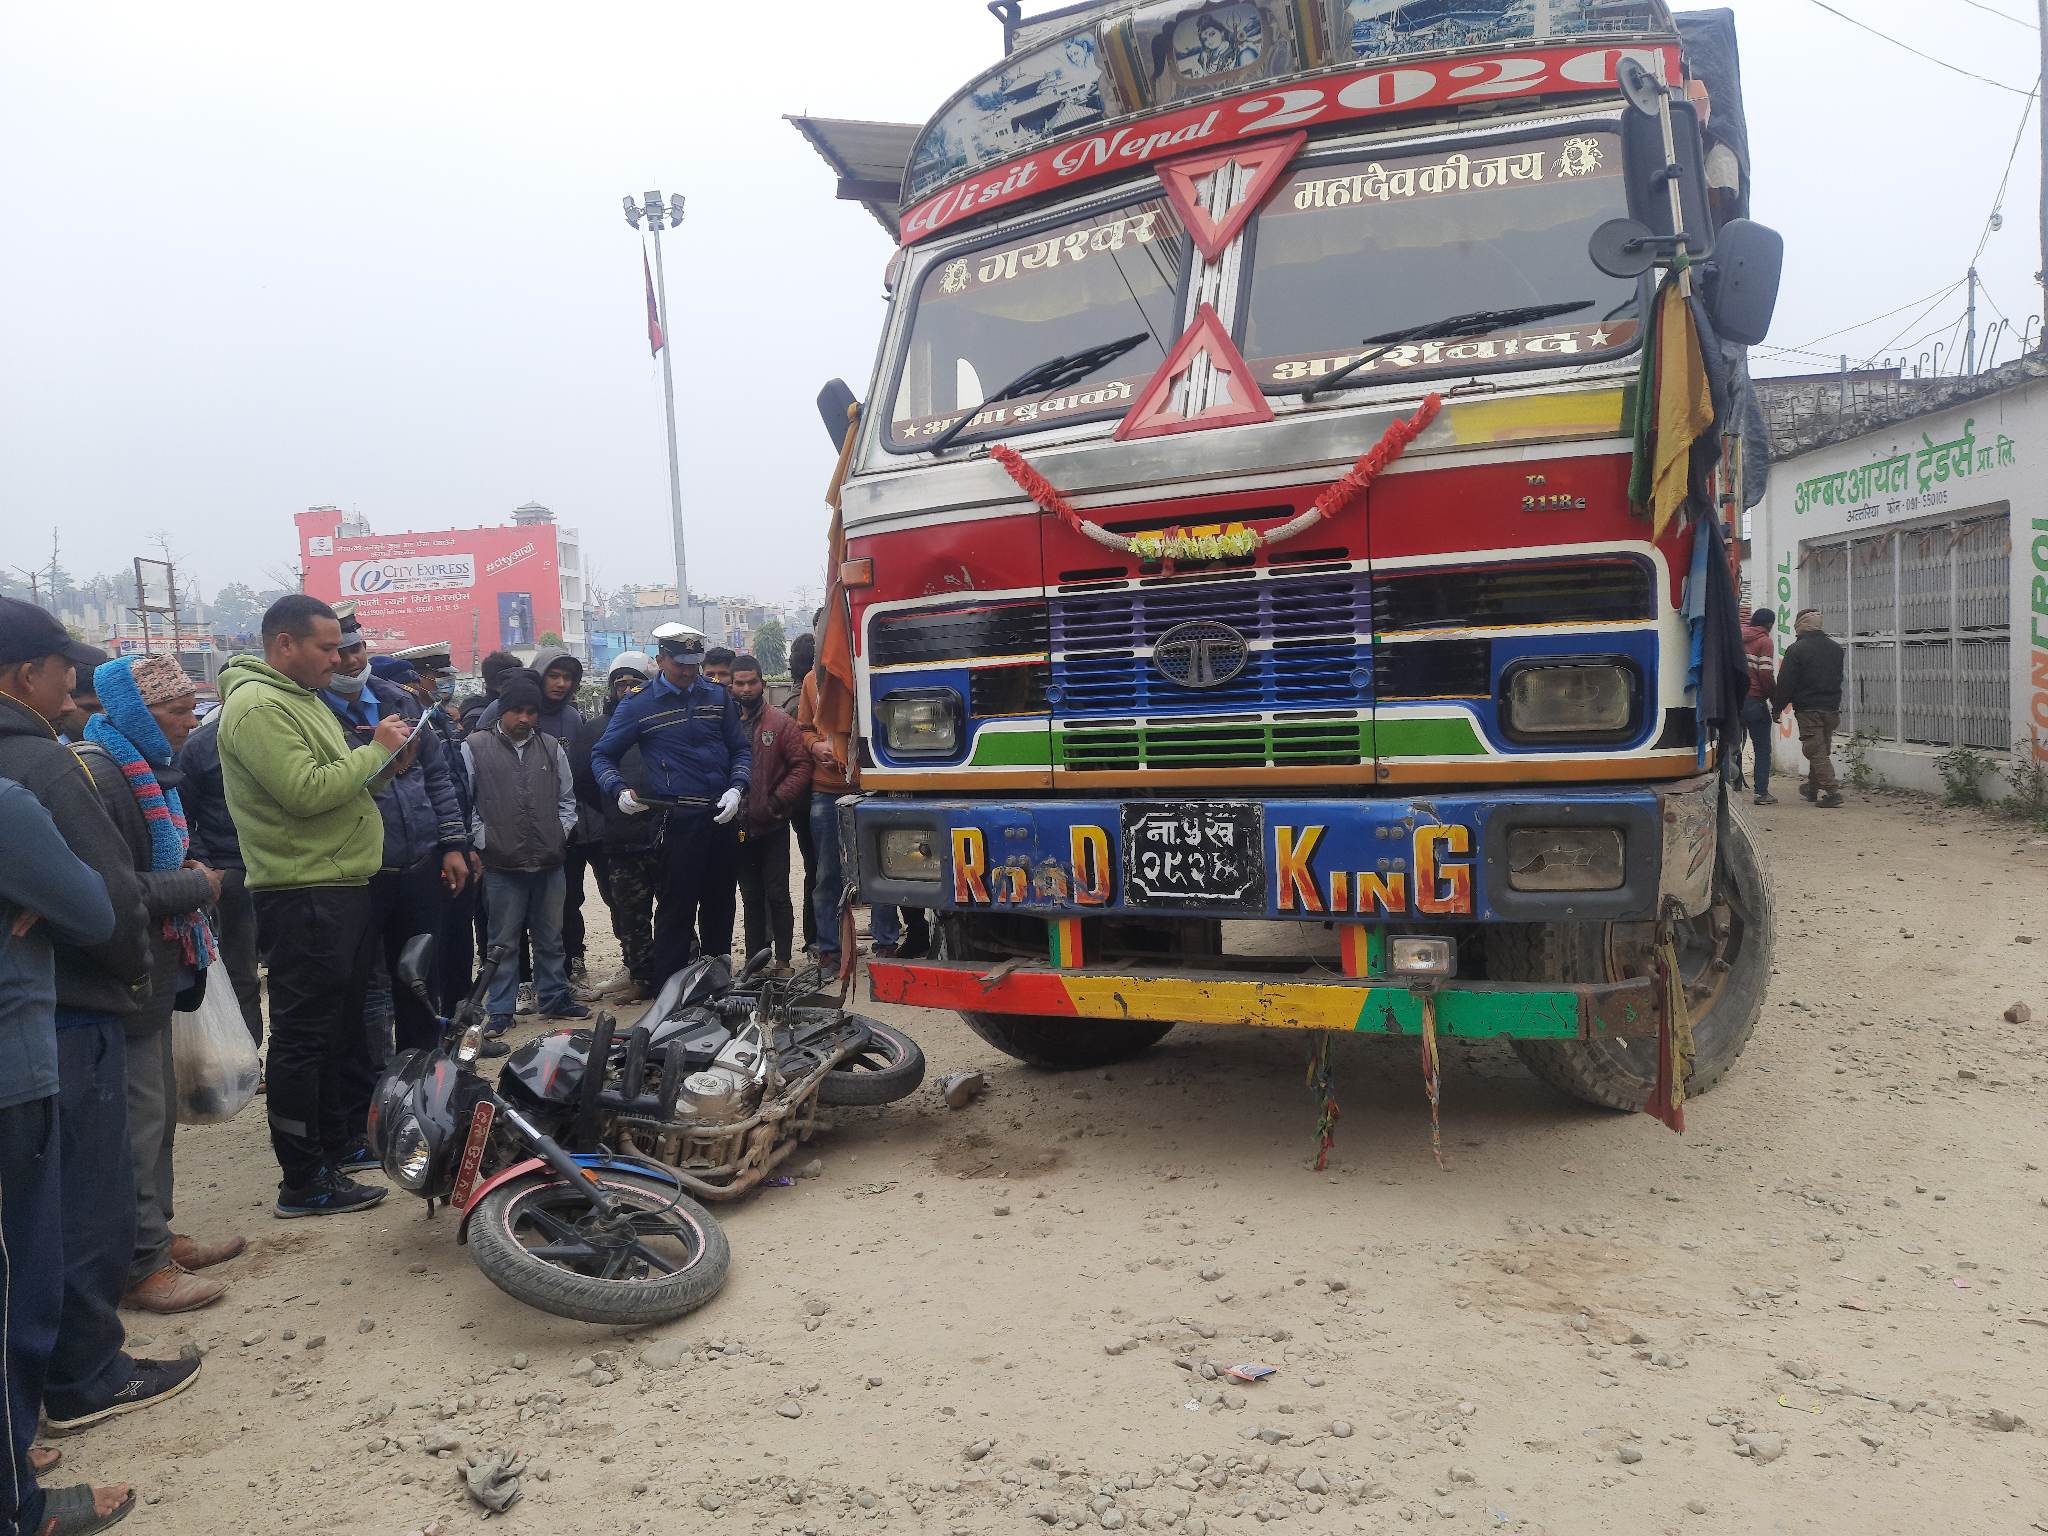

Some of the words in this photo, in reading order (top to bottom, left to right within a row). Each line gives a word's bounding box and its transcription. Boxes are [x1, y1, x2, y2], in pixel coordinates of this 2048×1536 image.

[905, 161, 1042, 234] Visit
[1052, 110, 1222, 176] Nepal
[1237, 48, 1666, 135] 2020
